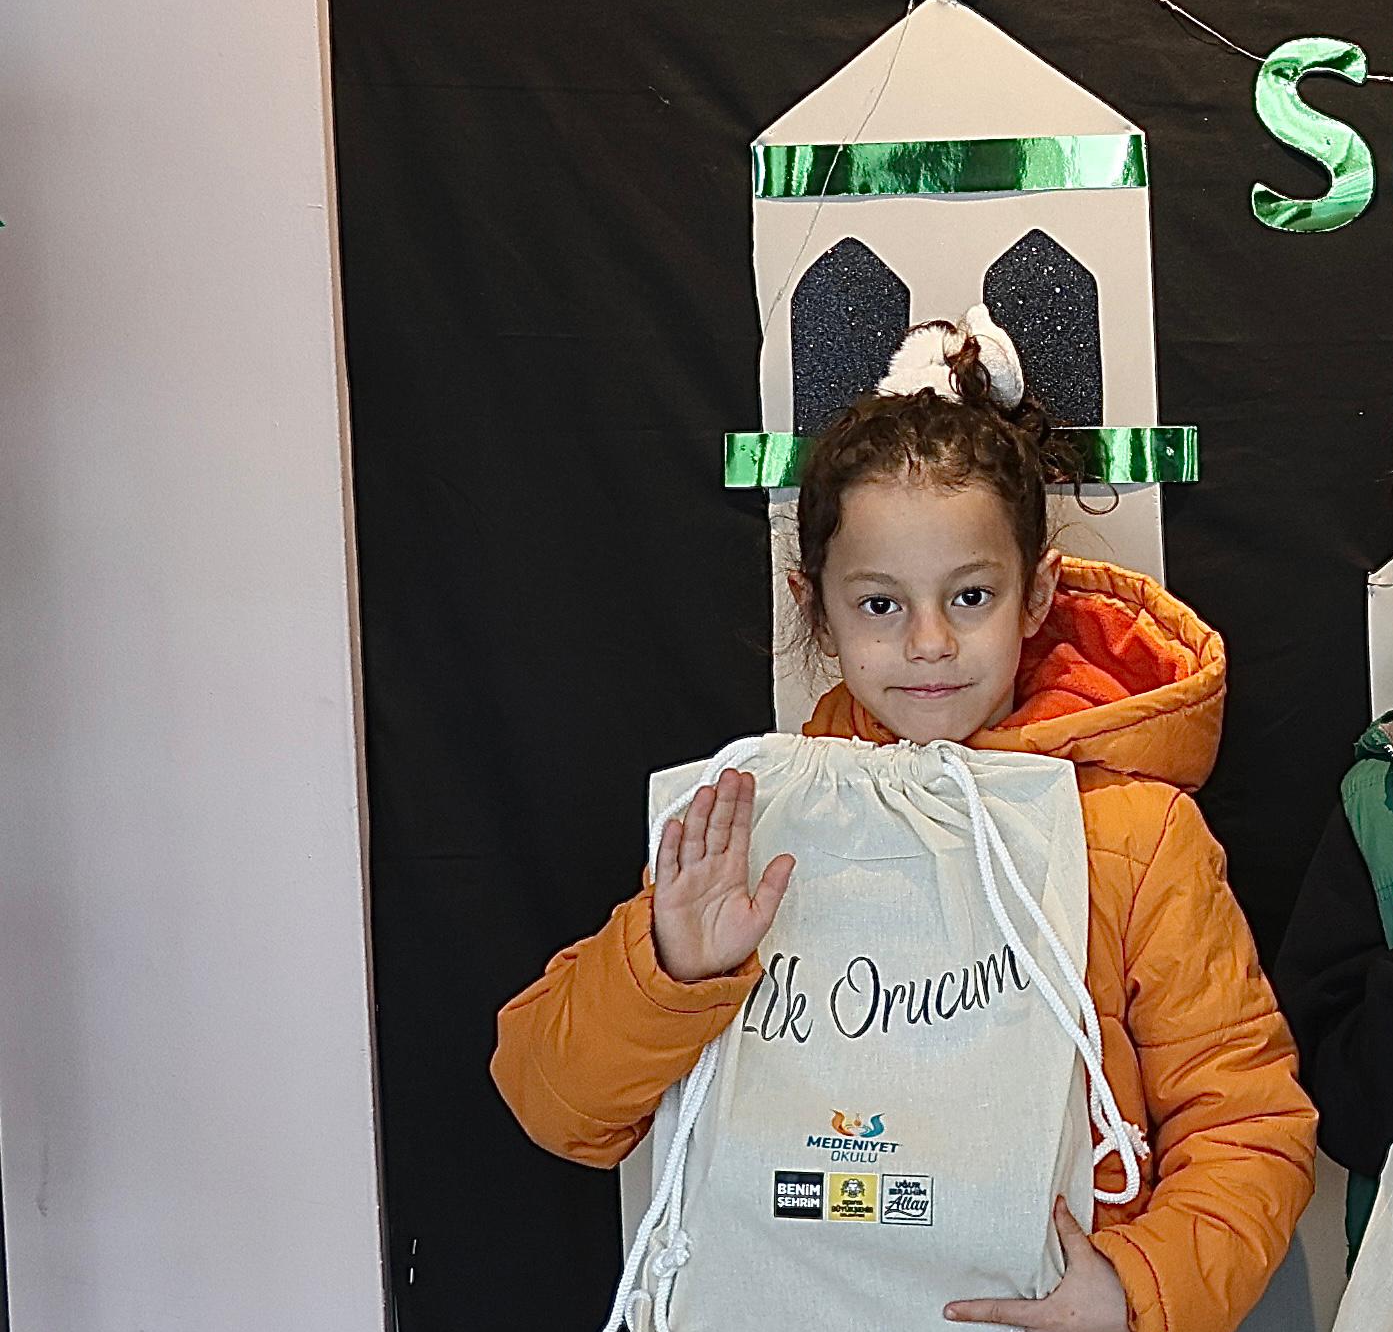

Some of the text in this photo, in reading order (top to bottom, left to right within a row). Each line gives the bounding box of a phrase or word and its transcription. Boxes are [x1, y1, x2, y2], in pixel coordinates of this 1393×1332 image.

[830, 943, 1031, 1039] Orucum
[831, 1150, 878, 1163] OKULU
[777, 1182, 821, 1196] BENİM
